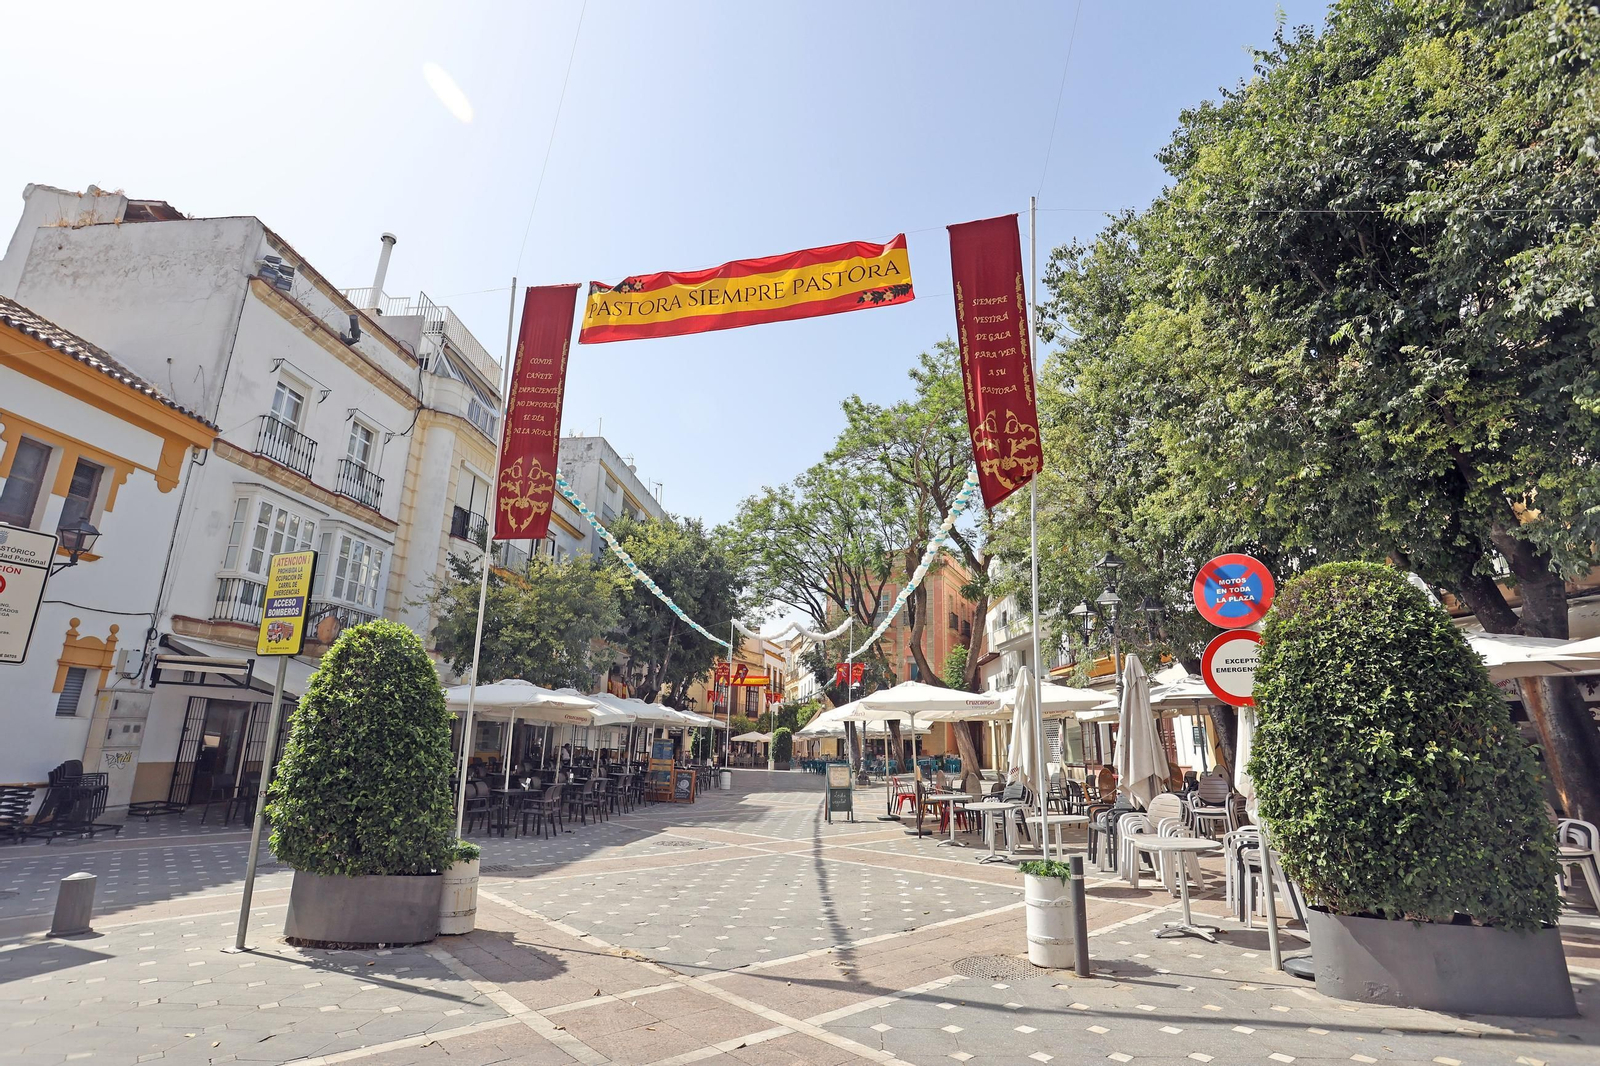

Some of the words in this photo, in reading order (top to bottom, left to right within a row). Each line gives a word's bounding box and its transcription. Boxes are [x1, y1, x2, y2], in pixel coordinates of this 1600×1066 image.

[588, 294, 682, 320] PASTORA
[688, 280, 785, 308] SIEMPRE
[792, 259, 901, 294] PASTORA
[972, 295, 1008, 307] SIEMPRE
[973, 311, 1009, 324] VESTIRÁ
[975, 333, 988, 341] DE
[988, 330, 1012, 342] GALA
[974, 350, 998, 359] PARA
[998, 347, 1017, 358] VER
[530, 357, 553, 365] CONDE
[526, 371, 554, 380] CAÑETE
[995, 367, 1007, 377] SU
[518, 386, 558, 394] IMPACIENTE
[981, 384, 1018, 395] PASTORA
[516, 400, 525, 408] NO
[525, 400, 557, 409] IMPORTA
[531, 413, 545, 422] DÍA
[513, 427, 521, 435] NI
[530, 428, 552, 437] HORA
[0, 545, 36, 557] STÓRICO
[14, 554, 47, 566] Peatonal
[1218, 577, 1247, 586] MOTOS
[273, 588, 300, 597] EMERGENCIAS
[1229, 586, 1251, 594] TODA
[273, 598, 297, 608] ACCESO
[1216, 596, 1227, 604] LA
[1228, 594, 1255, 603] PLAZA
[267, 607, 300, 618] BOMBEROS
[1225, 657, 1260, 665] EXCEPTO
[966, 699, 995, 707] Cruzcampo
[564, 713, 588, 722] Cruzcampo
